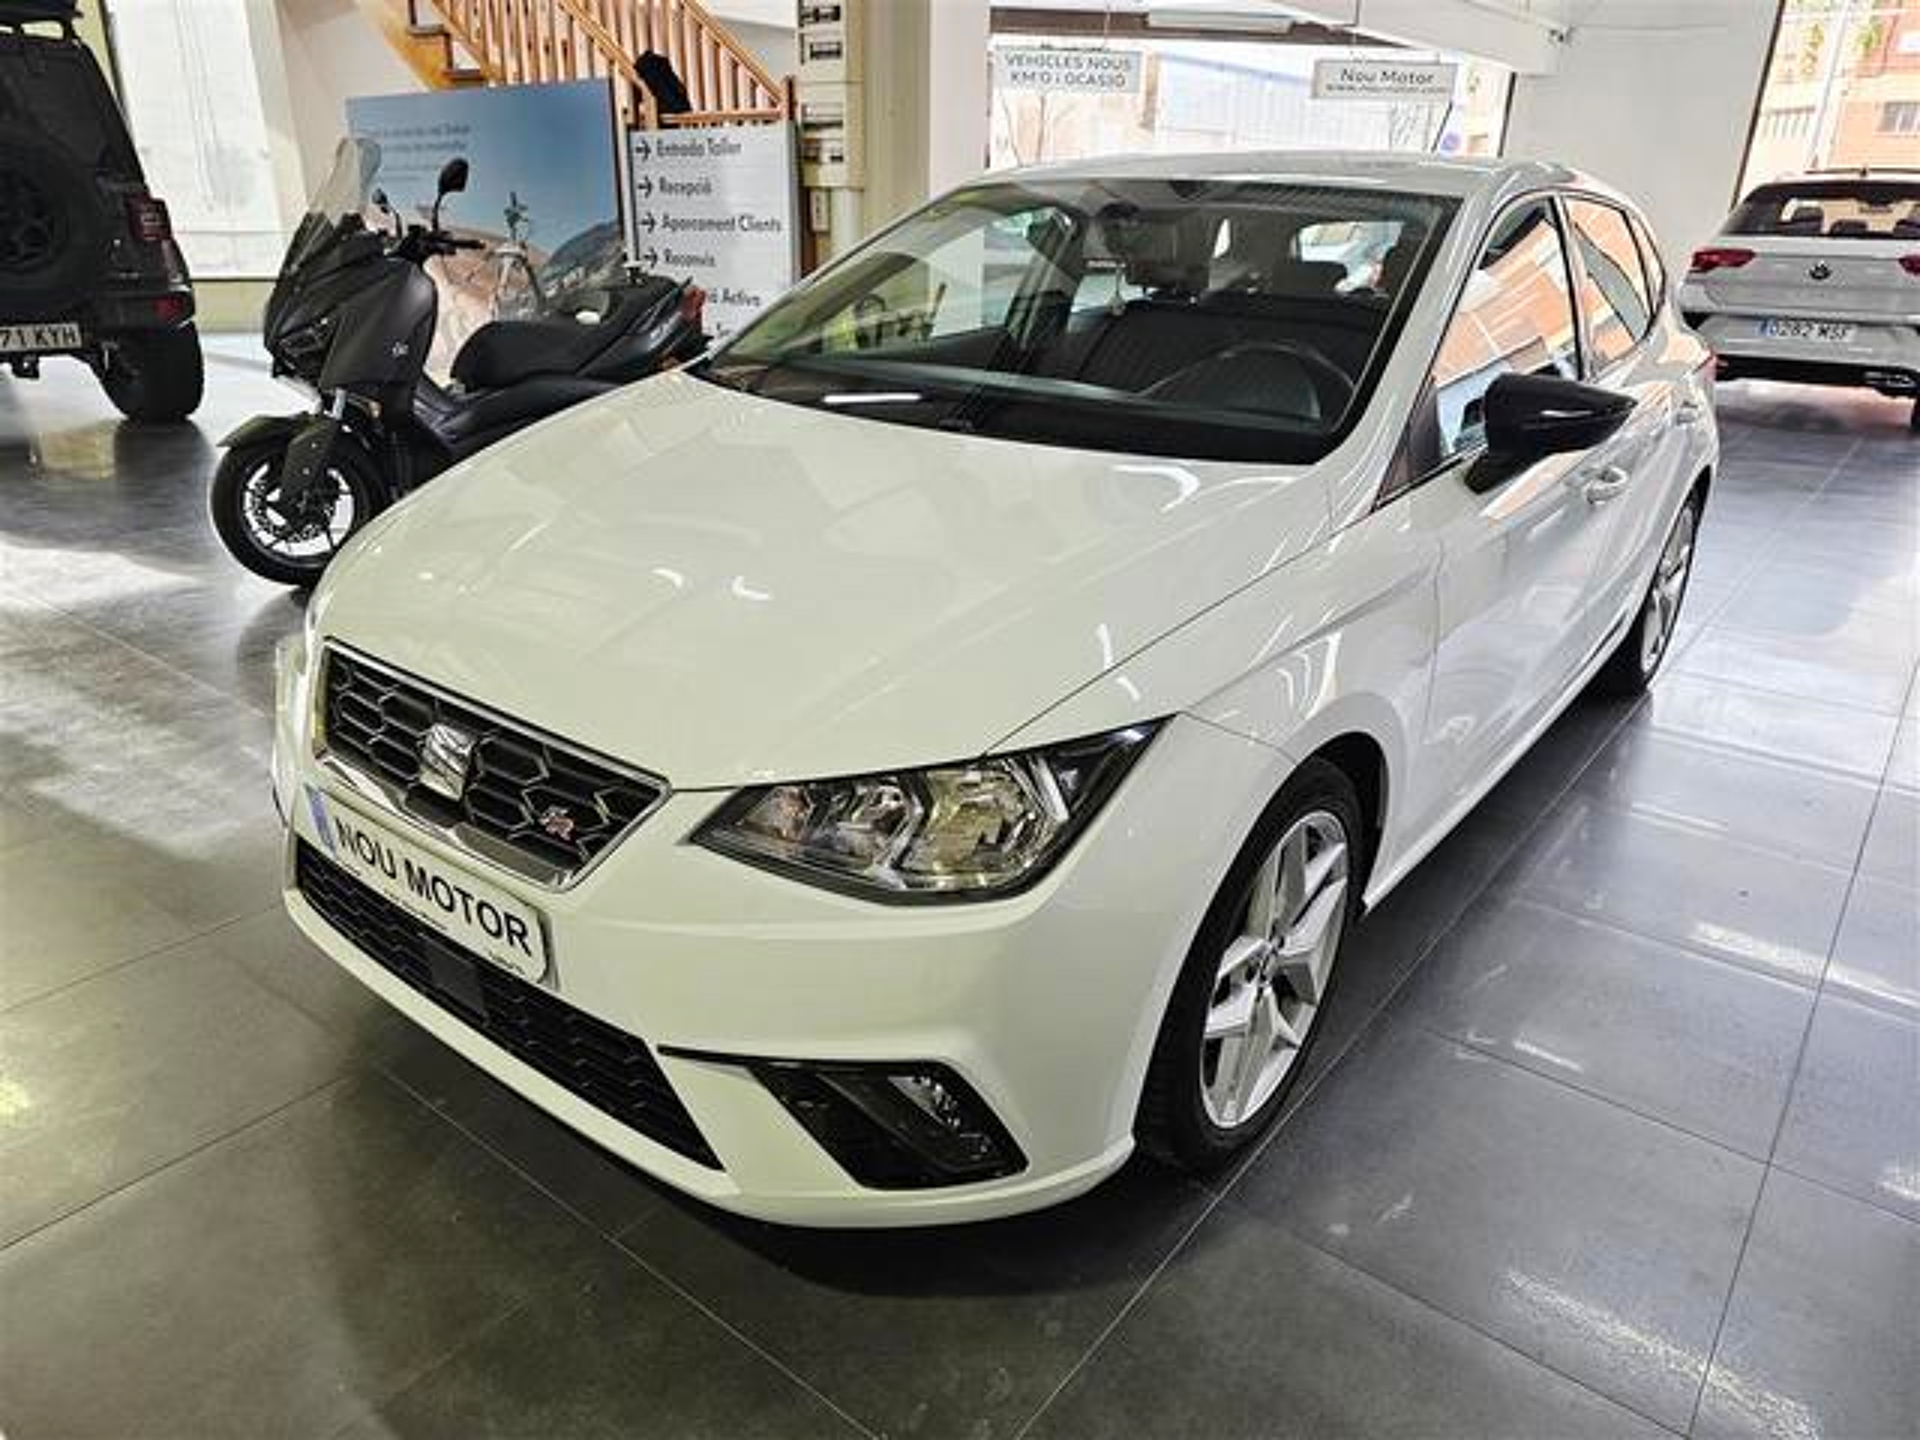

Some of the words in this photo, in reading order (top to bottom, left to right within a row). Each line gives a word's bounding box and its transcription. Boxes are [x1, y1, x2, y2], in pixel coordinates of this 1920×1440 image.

[1005, 54, 1083, 69] VEHICLES
[1087, 56, 1131, 71] NOUS
[1340, 68, 1377, 82] Nou
[1380, 70, 1434, 84] Motor
[656, 137, 705, 157] Entrada
[707, 137, 742, 156] Taller
[738, 213, 782, 232] Clients
[335, 817, 397, 880] NOU
[404, 857, 532, 958] MOTOR
